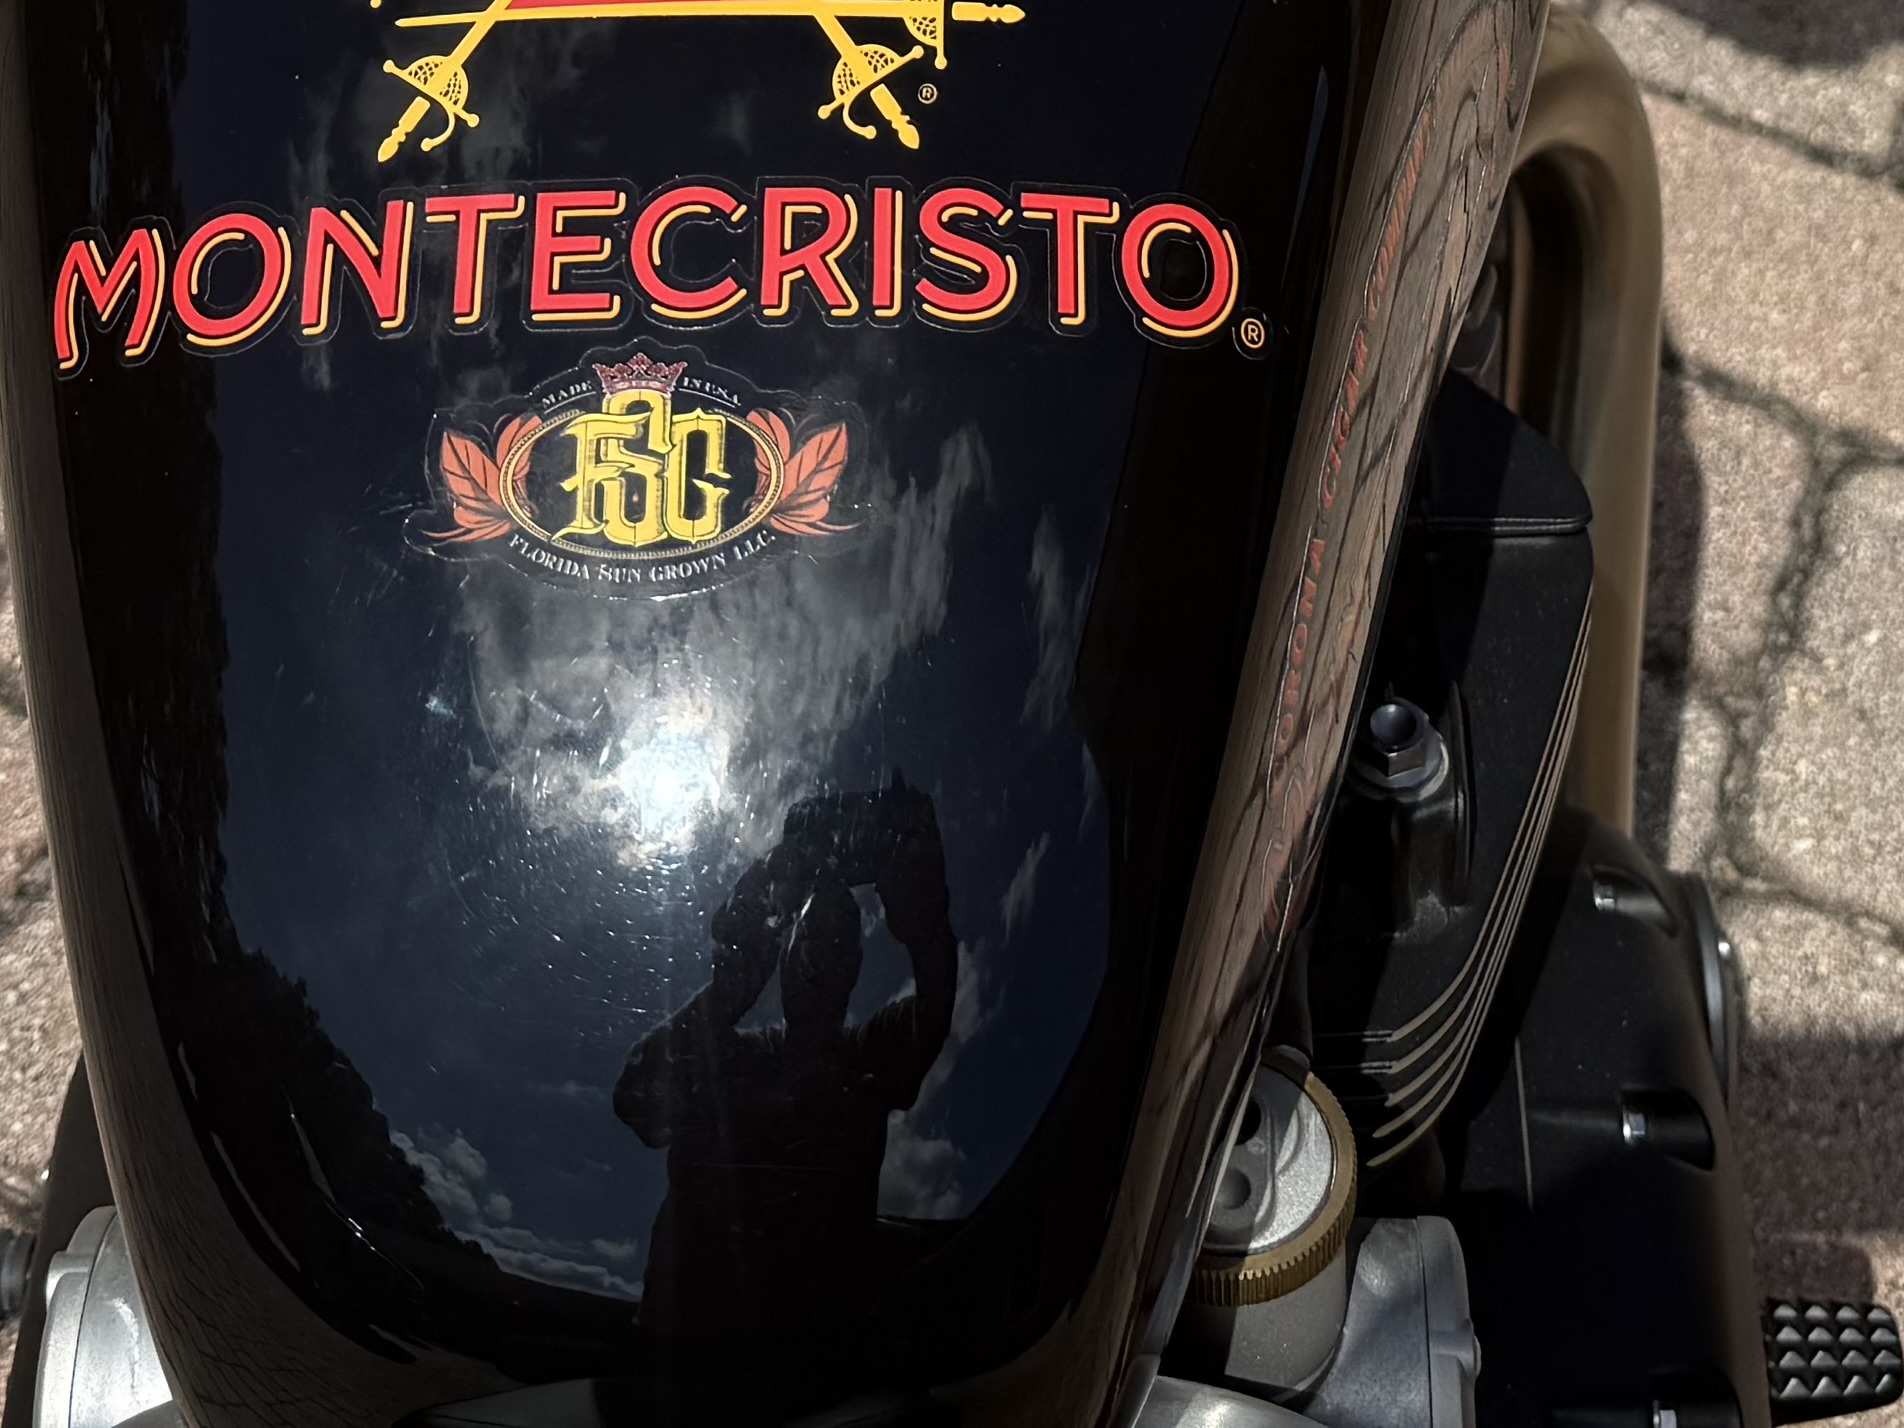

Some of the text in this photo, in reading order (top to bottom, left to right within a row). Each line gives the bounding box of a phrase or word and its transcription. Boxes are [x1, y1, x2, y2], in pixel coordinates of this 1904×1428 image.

[53, 187, 1239, 372] MONTECRISTO
[541, 379, 593, 408] MADE
[508, 533, 591, 580] FLORIDA
[598, 563, 642, 583] SUN
[648, 552, 727, 582] GROWN
